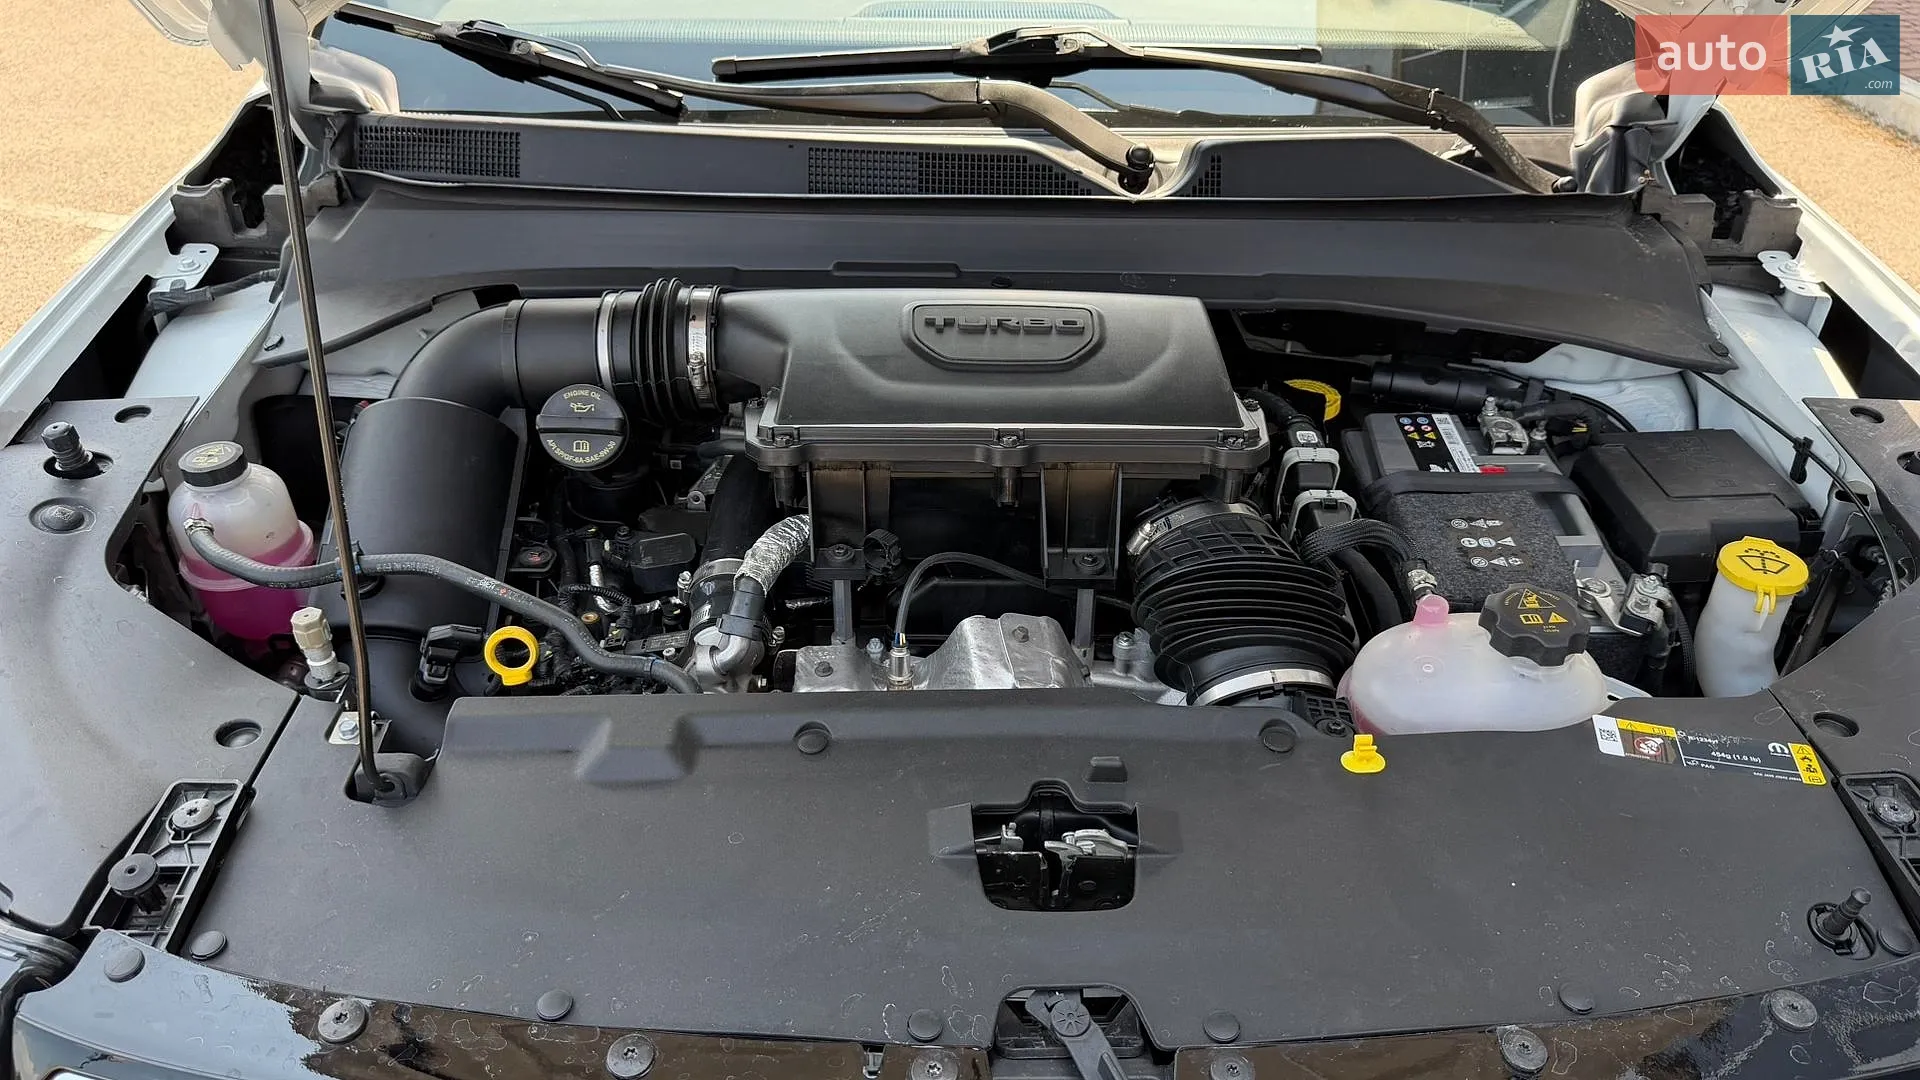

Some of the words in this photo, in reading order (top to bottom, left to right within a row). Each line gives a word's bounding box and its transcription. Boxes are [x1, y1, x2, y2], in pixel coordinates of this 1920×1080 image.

[924, 315, 1086, 335] TURBO
[563, 390, 590, 399] ENGINE
[590, 391, 601, 400] OIL
